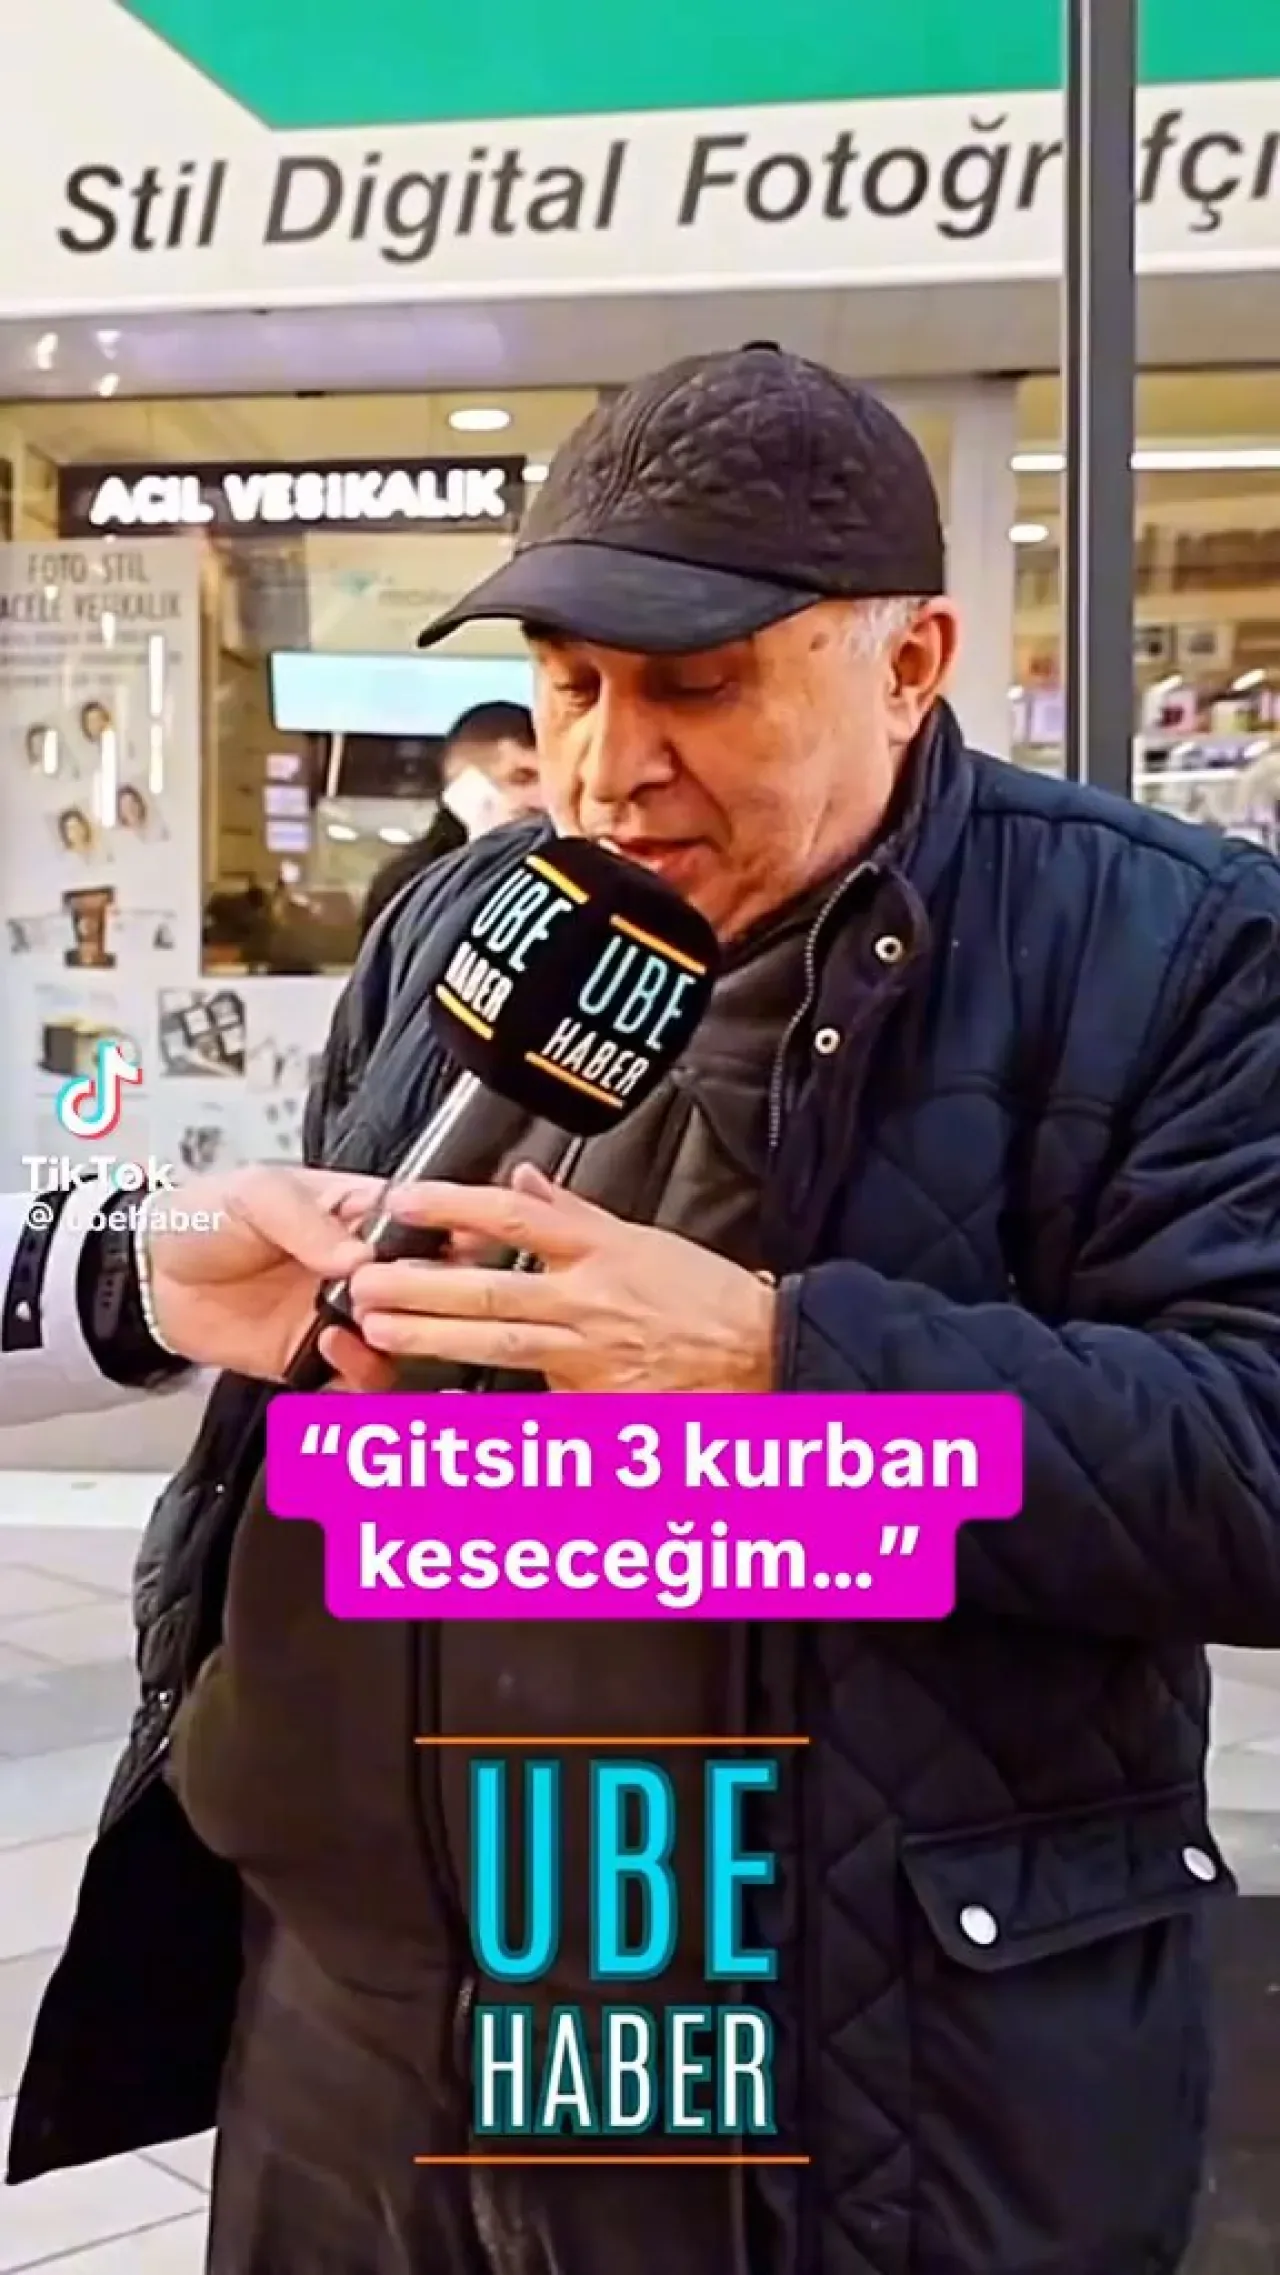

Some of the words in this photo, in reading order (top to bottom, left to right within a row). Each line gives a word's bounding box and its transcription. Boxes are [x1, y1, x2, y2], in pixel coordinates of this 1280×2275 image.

[57, 160, 227, 254] Stil
[262, 137, 628, 265] Digital
[677, 109, 1280, 241] Fotoğrfçı
[471, 868, 574, 972] UBE
[578, 935, 697, 1050] UBE
[541, 1017, 650, 1097] HABER
